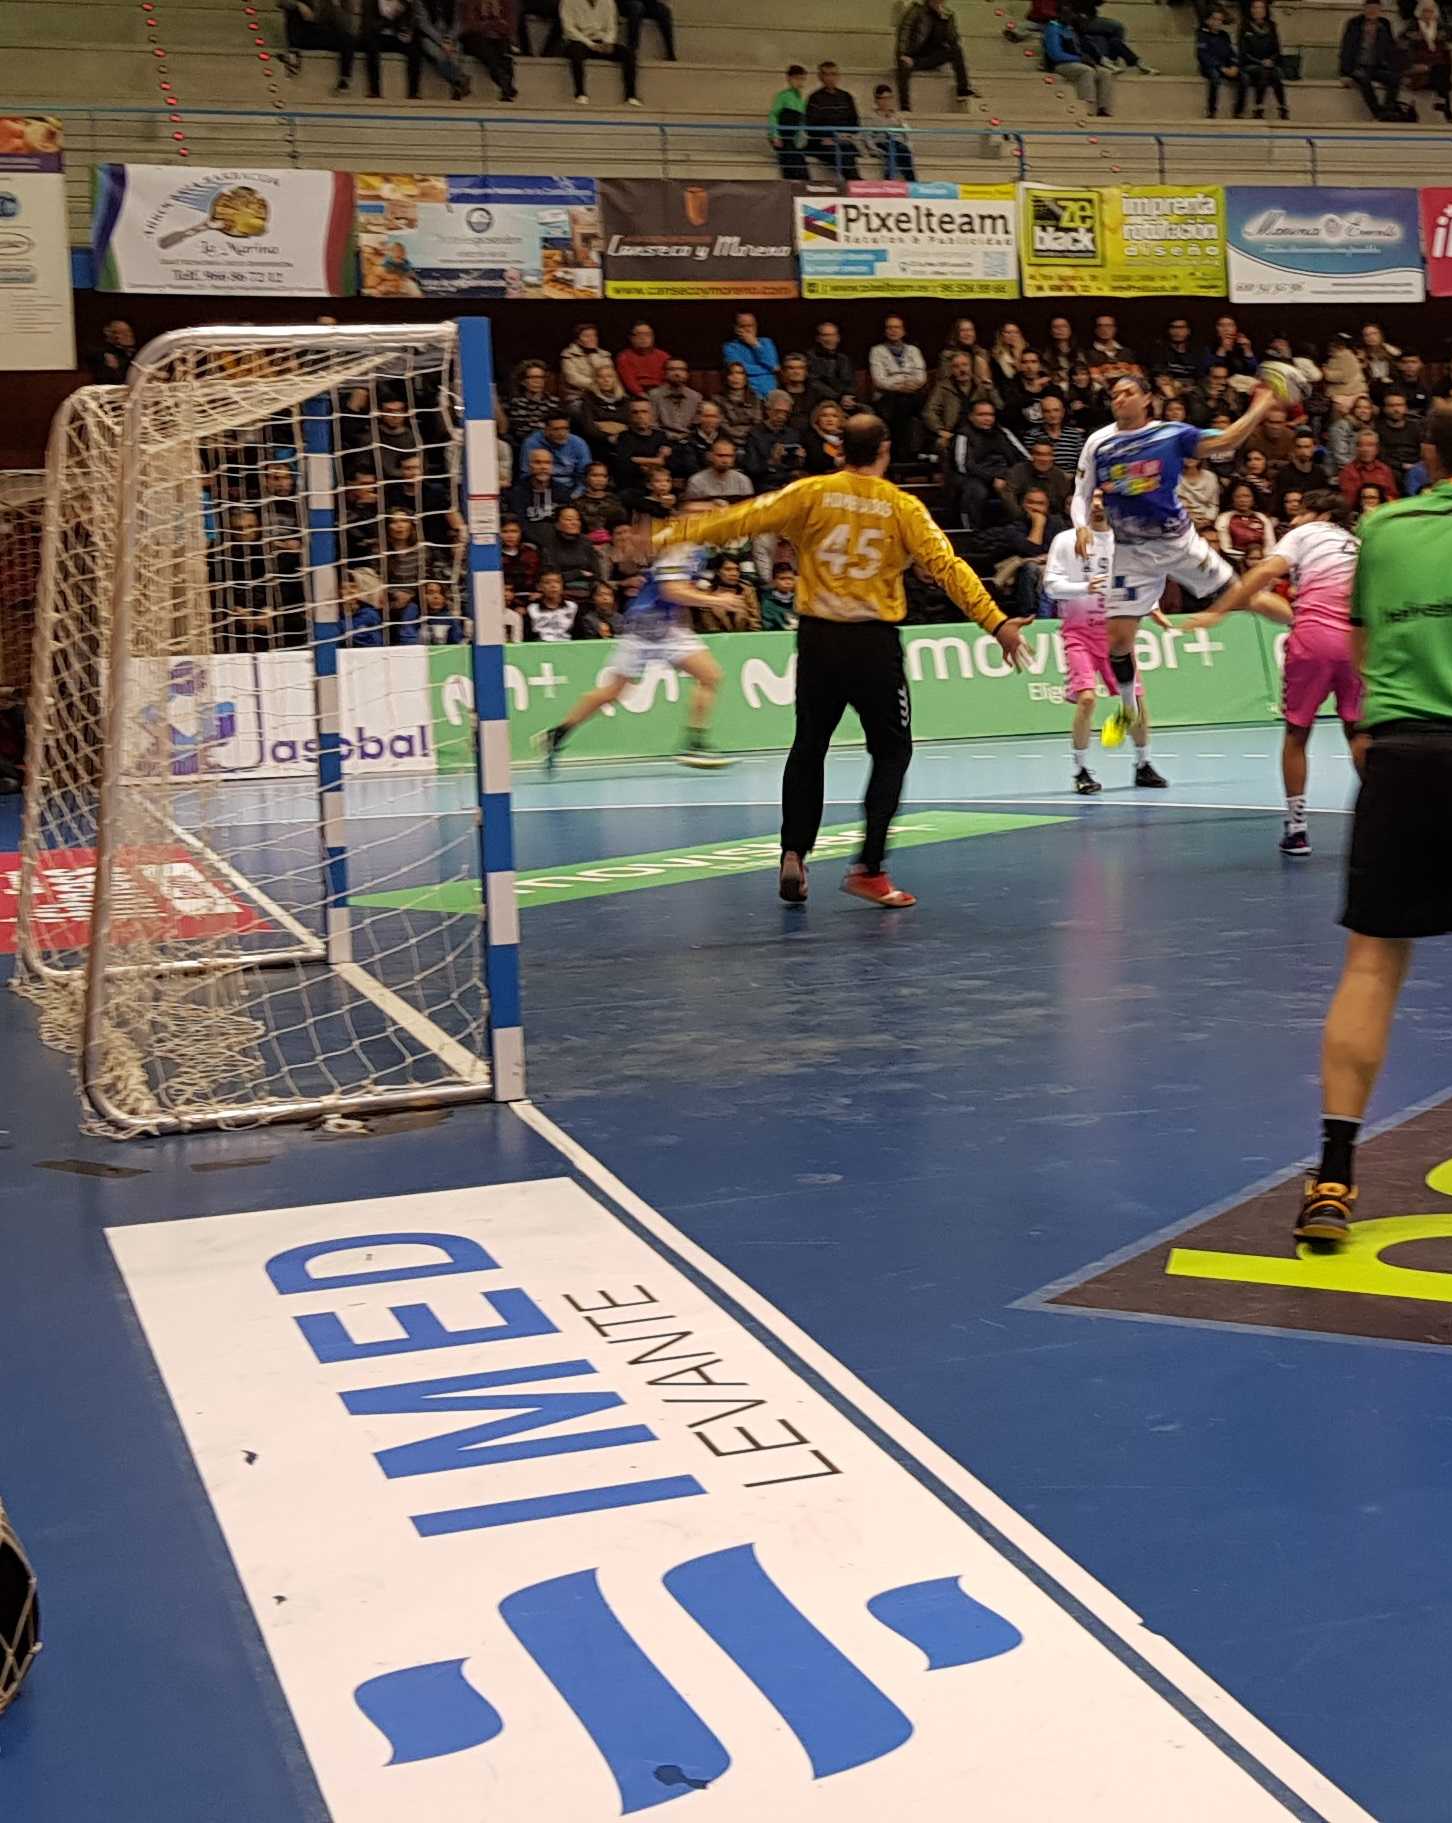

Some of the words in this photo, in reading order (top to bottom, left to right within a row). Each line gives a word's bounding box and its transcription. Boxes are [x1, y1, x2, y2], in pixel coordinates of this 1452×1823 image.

[843, 204, 1010, 234] Pixelteam
[816, 523, 882, 580] 45
[562, 1283, 842, 1488] LEVANTE
